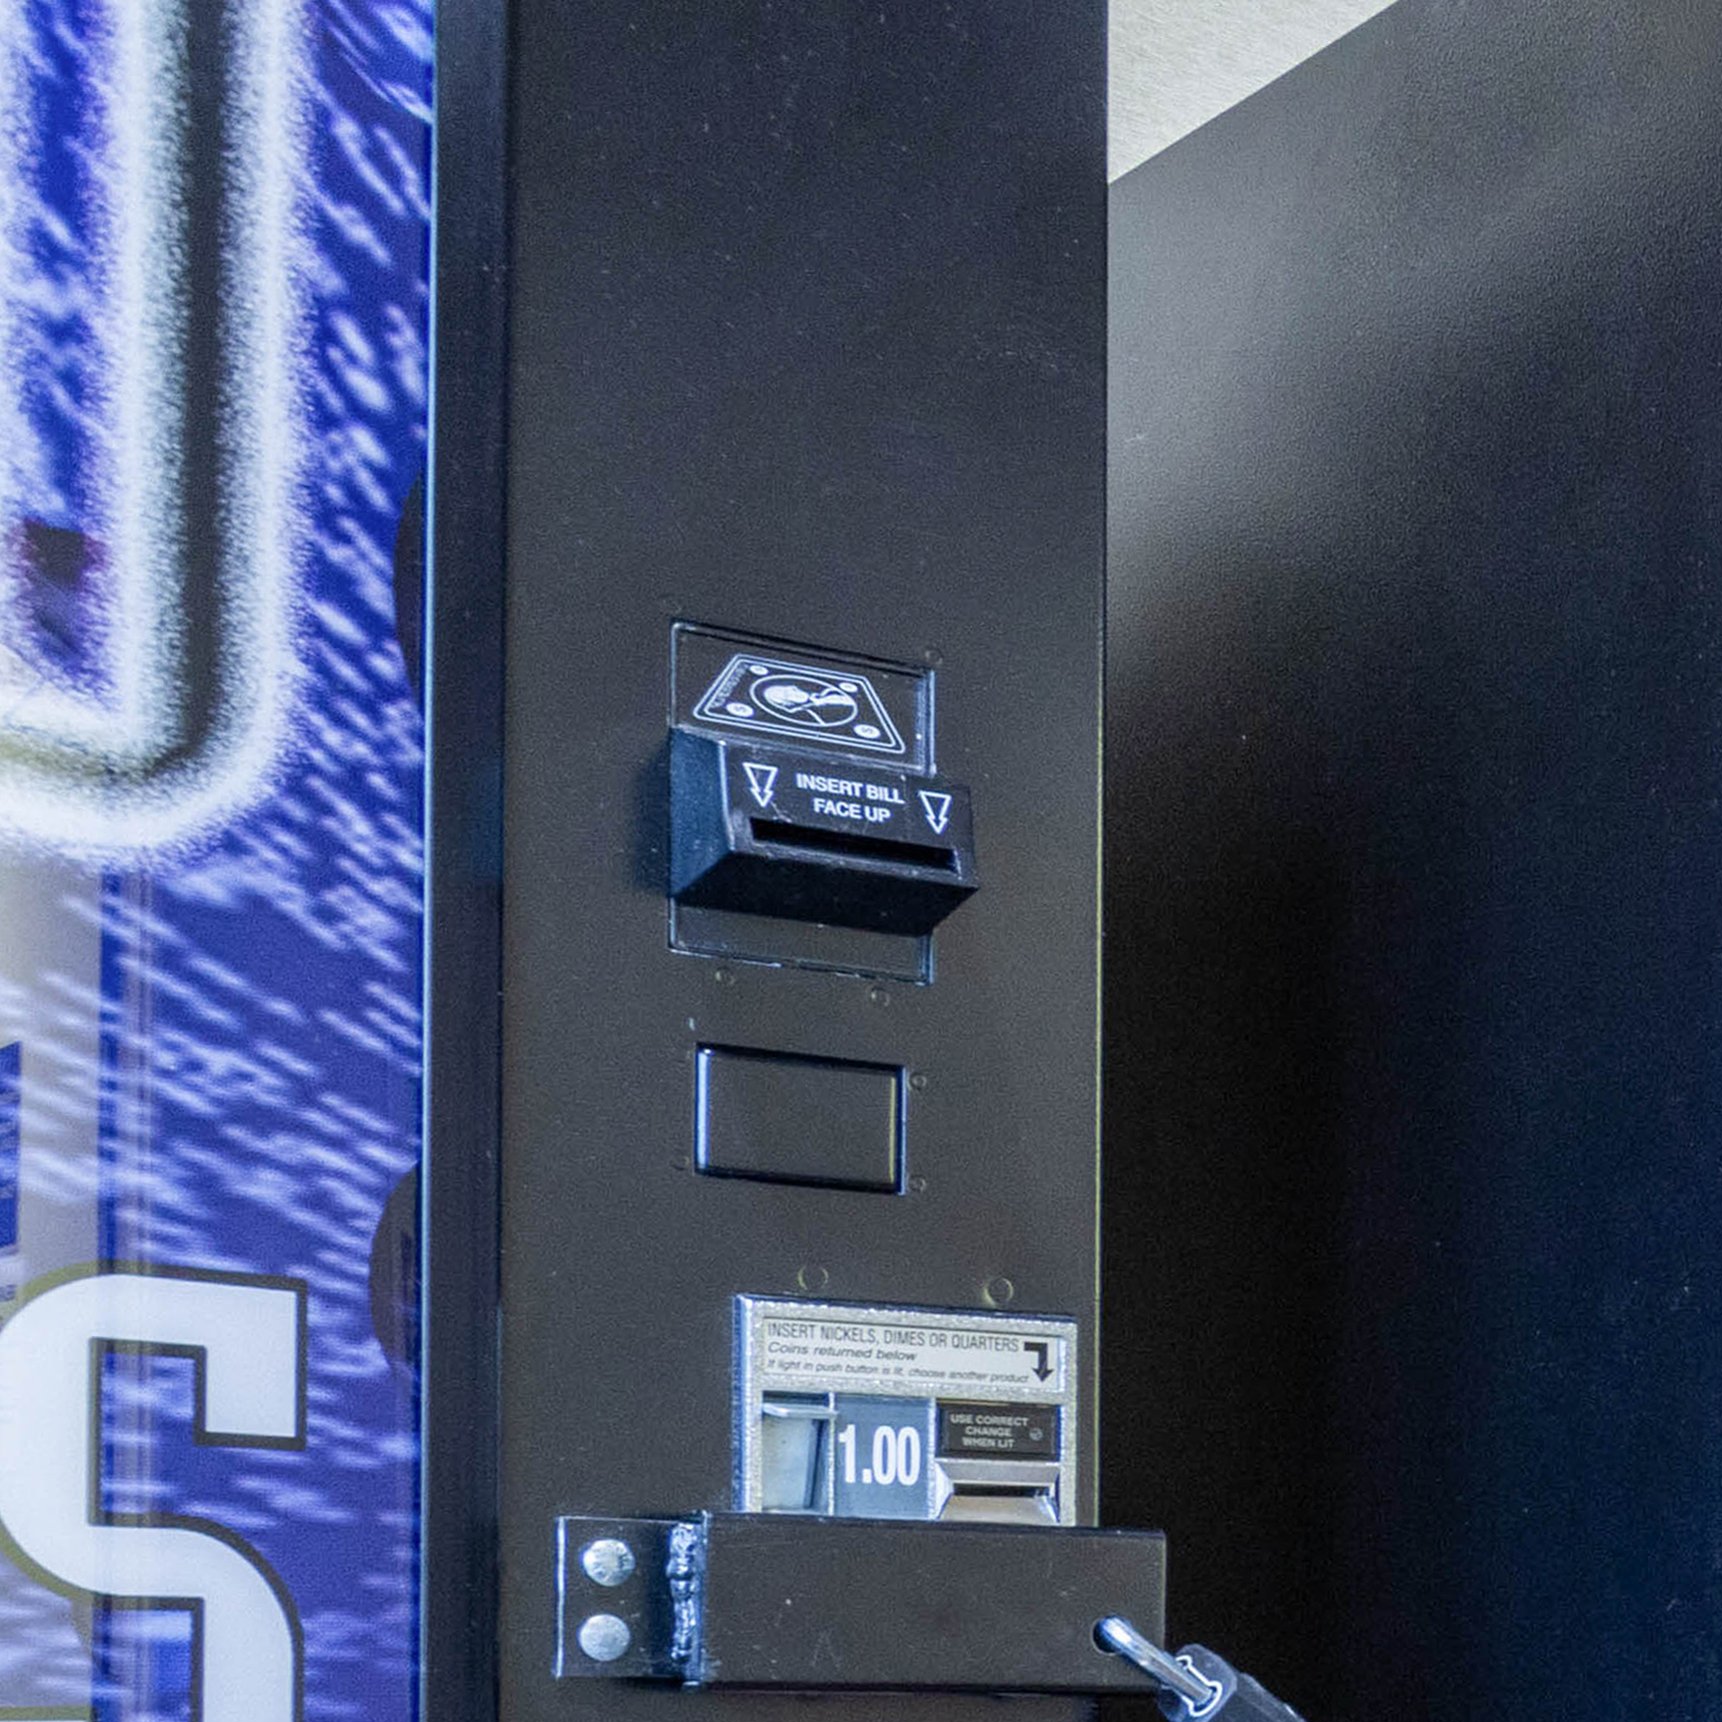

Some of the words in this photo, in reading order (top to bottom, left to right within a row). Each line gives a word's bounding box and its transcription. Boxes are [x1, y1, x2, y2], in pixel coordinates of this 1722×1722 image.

[796, 772, 864, 801] INSERT
[866, 780, 906, 805] BILL
[813, 798, 864, 820] FACE
[865, 804, 892, 824] UP
[767, 1322, 817, 1342] INSERT
[819, 1324, 881, 1345] NICKELS,
[883, 1328, 925, 1347] DIMES
[929, 1331, 949, 1348] OR
[951, 1333, 1020, 1353] QUARTERS
[767, 1341, 810, 1357] Coins
[813, 1344, 872, 1360] returned
[875, 1347, 918, 1363] below
[816, 1361, 843, 1377] push
[845, 1360, 879, 1375] button
[950, 1413, 975, 1427] USE
[975, 1415, 1030, 1428] CORRECT
[962, 1436, 995, 1449] WHEN
[997, 1437, 1016, 1450] LIT
[965, 1426, 1013, 1438] CHANGE
[838, 1424, 921, 1486] 1.00
